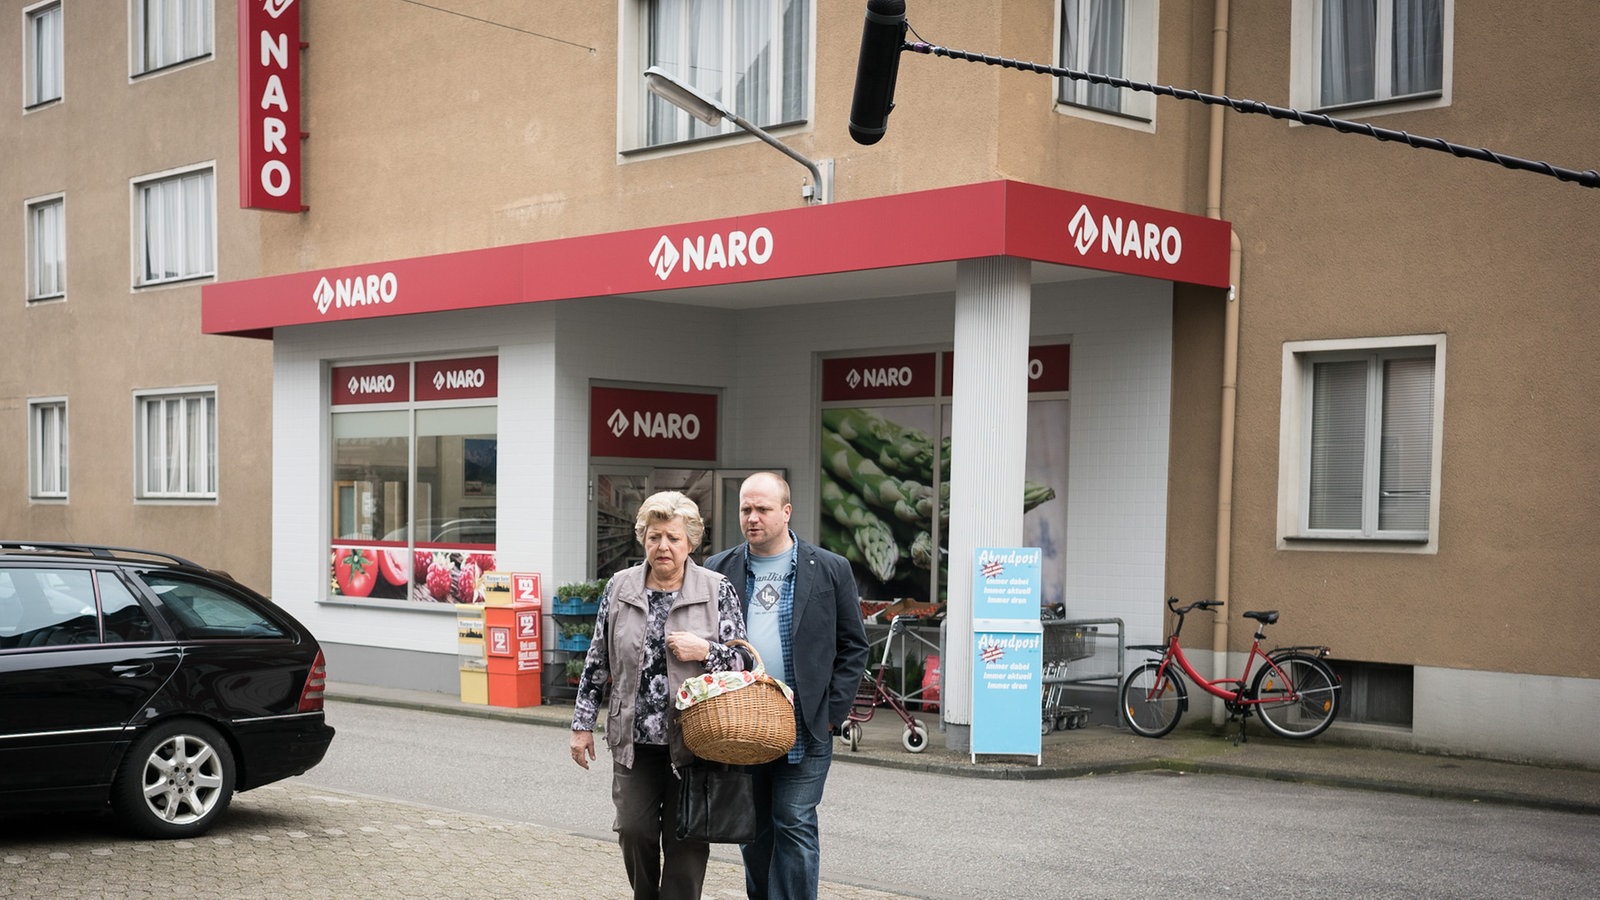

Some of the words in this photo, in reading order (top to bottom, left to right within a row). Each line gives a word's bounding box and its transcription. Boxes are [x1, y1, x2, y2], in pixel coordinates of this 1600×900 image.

[260, 30, 290, 197] NARO
[682, 227, 774, 273] NARO
[1101, 214, 1182, 265] NARO
[335, 272, 398, 308] NARO
[360, 374, 395, 393] NARO
[447, 368, 485, 390] NARO
[863, 366, 913, 388] NARO
[633, 410, 701, 440] NARO
[1007, 672, 1032, 680] aktuell
